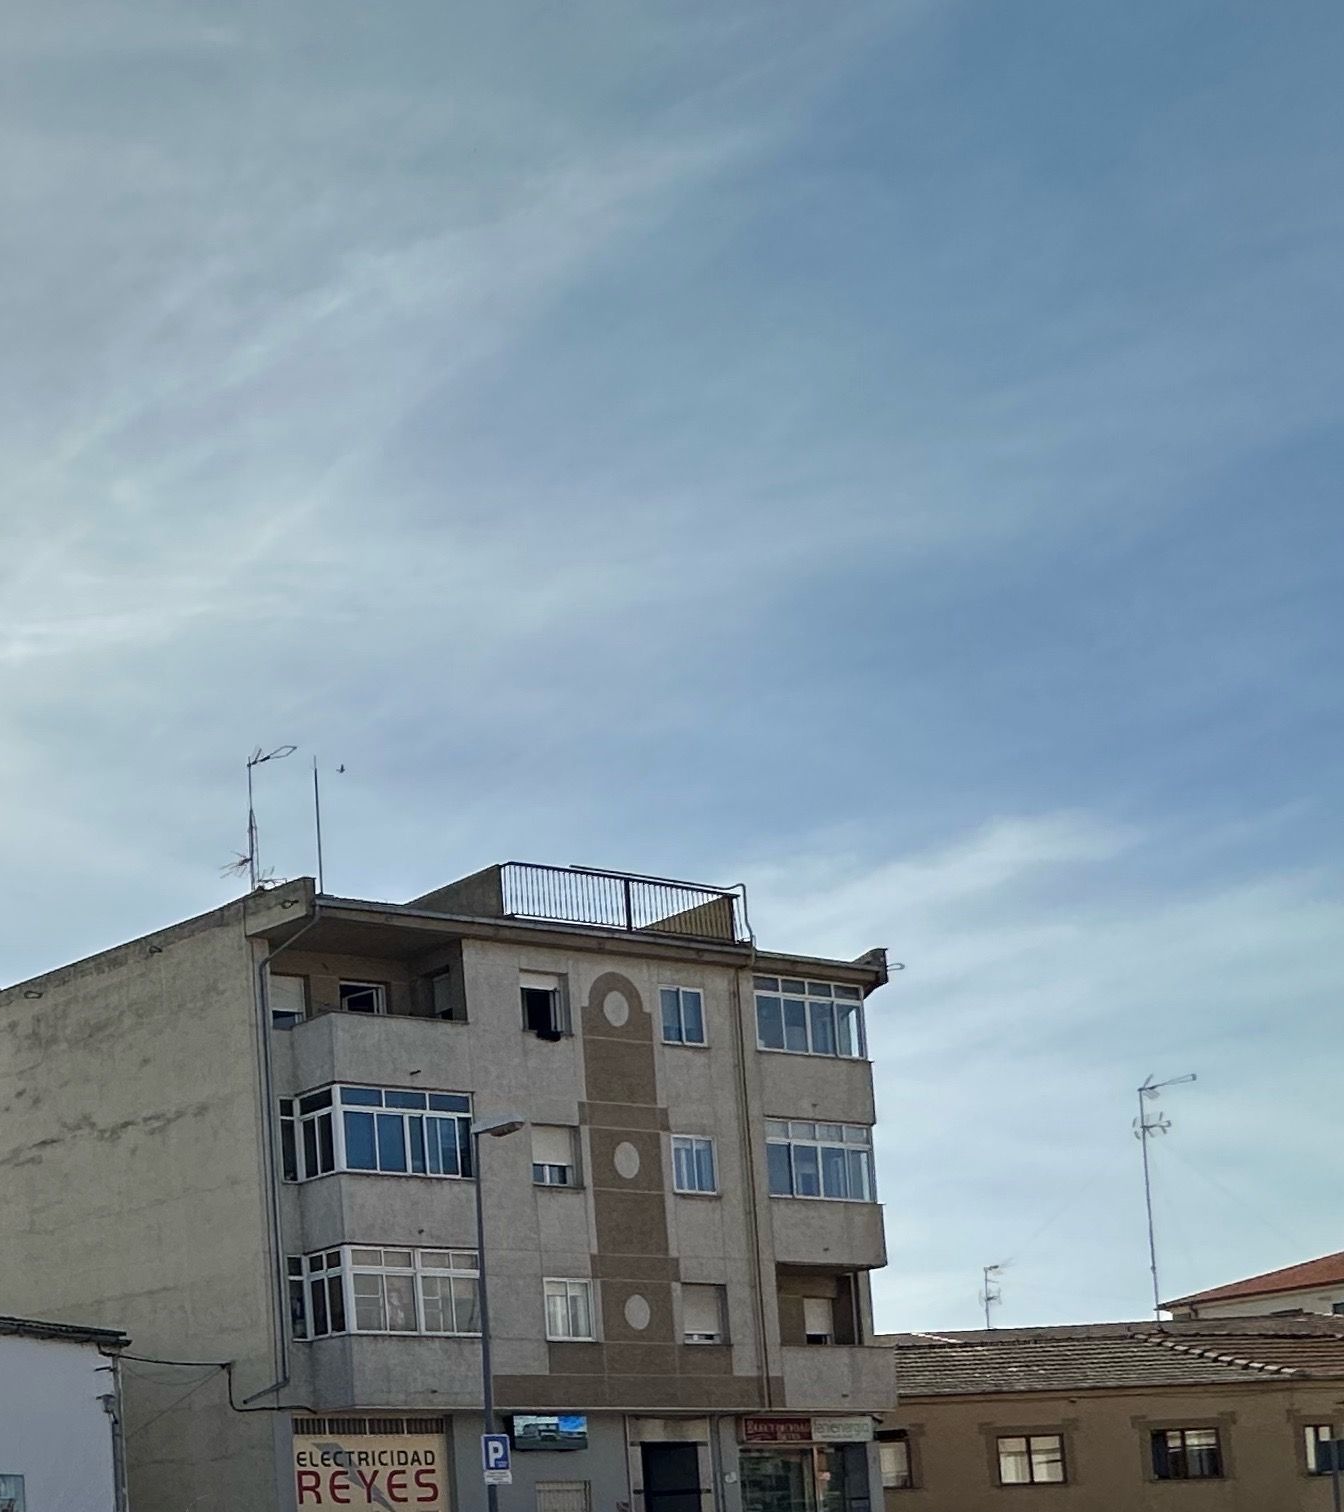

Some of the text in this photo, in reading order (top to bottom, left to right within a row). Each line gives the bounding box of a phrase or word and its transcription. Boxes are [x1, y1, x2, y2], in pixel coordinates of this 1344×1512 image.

[296, 1450, 435, 1467] ELECTRICIDAD
[488, 1440, 504, 1468] P
[297, 1468, 439, 1504] REYES
